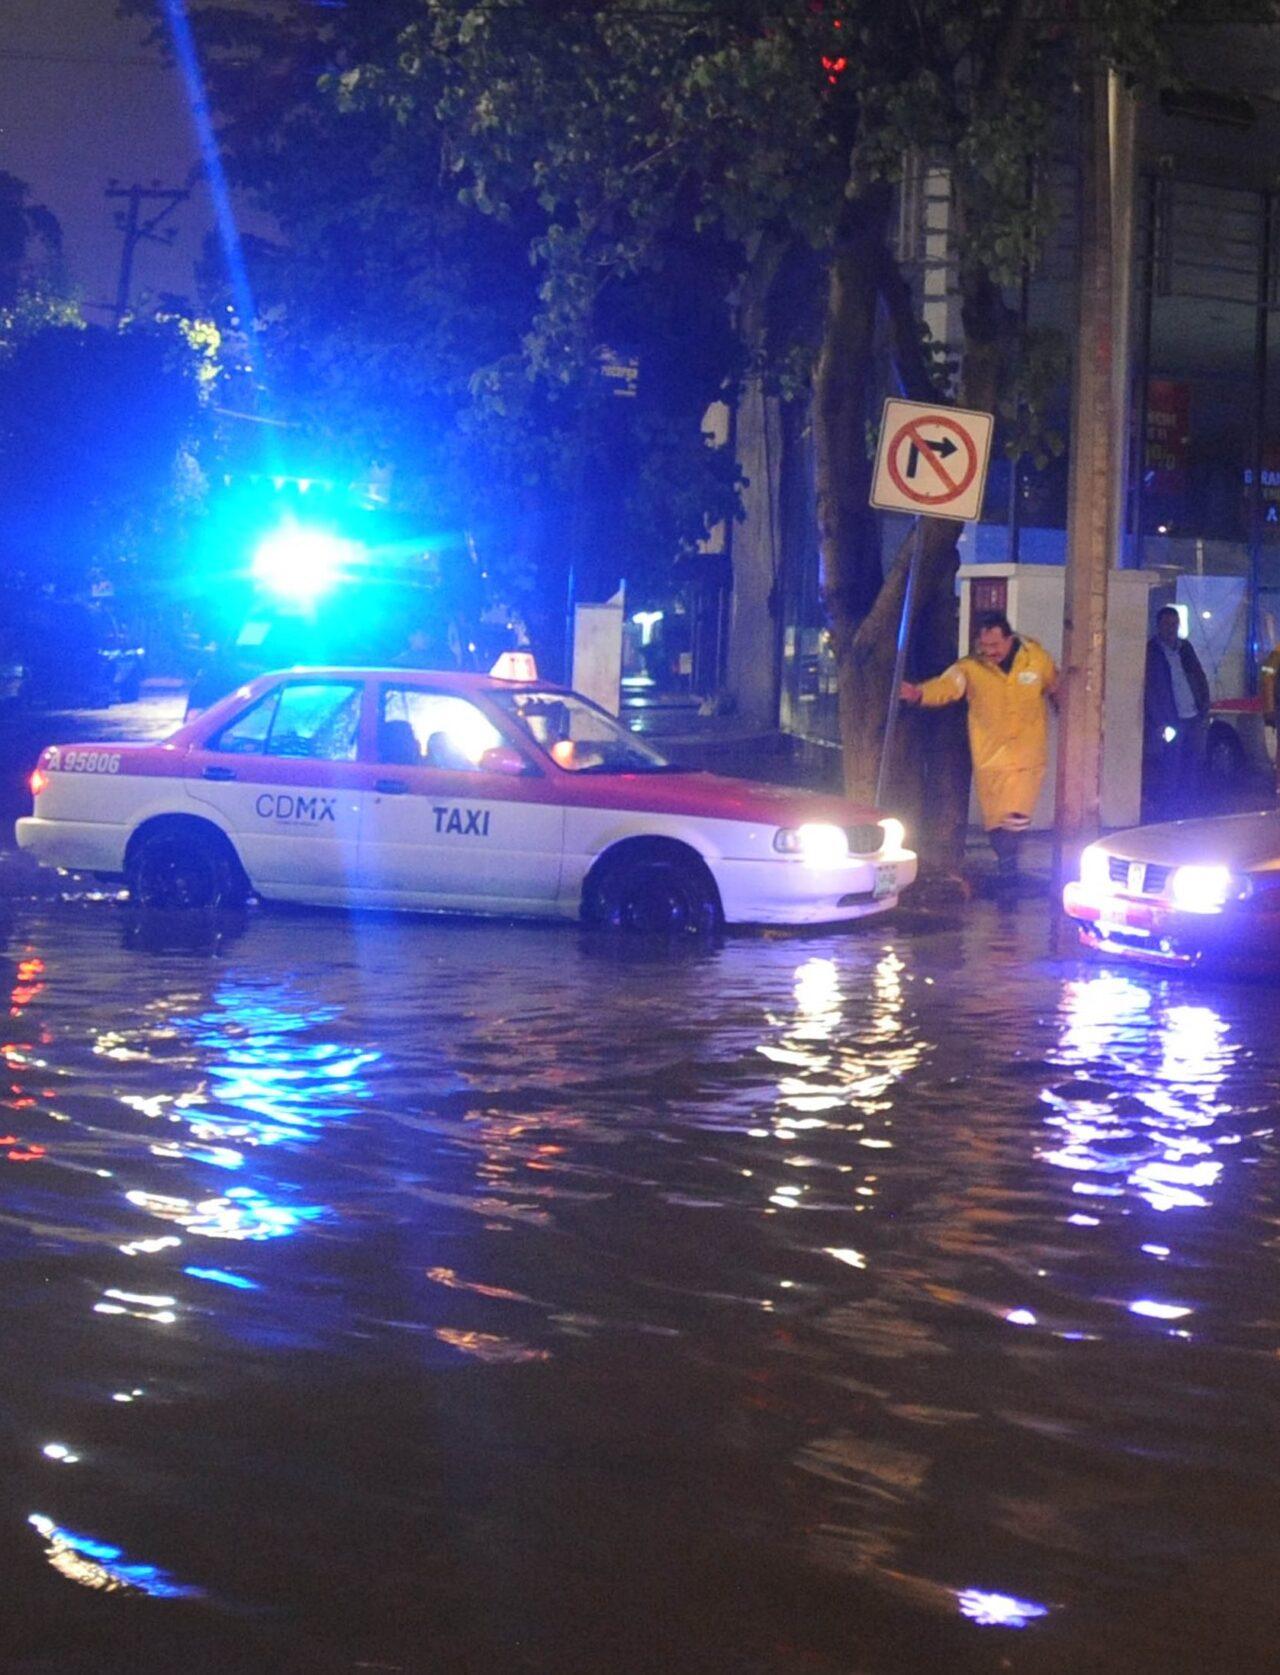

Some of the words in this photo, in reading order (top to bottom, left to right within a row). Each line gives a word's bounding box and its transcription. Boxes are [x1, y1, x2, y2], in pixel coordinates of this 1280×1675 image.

[64, 751, 121, 773] 95806
[255, 793, 337, 821] CDMX
[432, 806, 490, 836] TAXI
